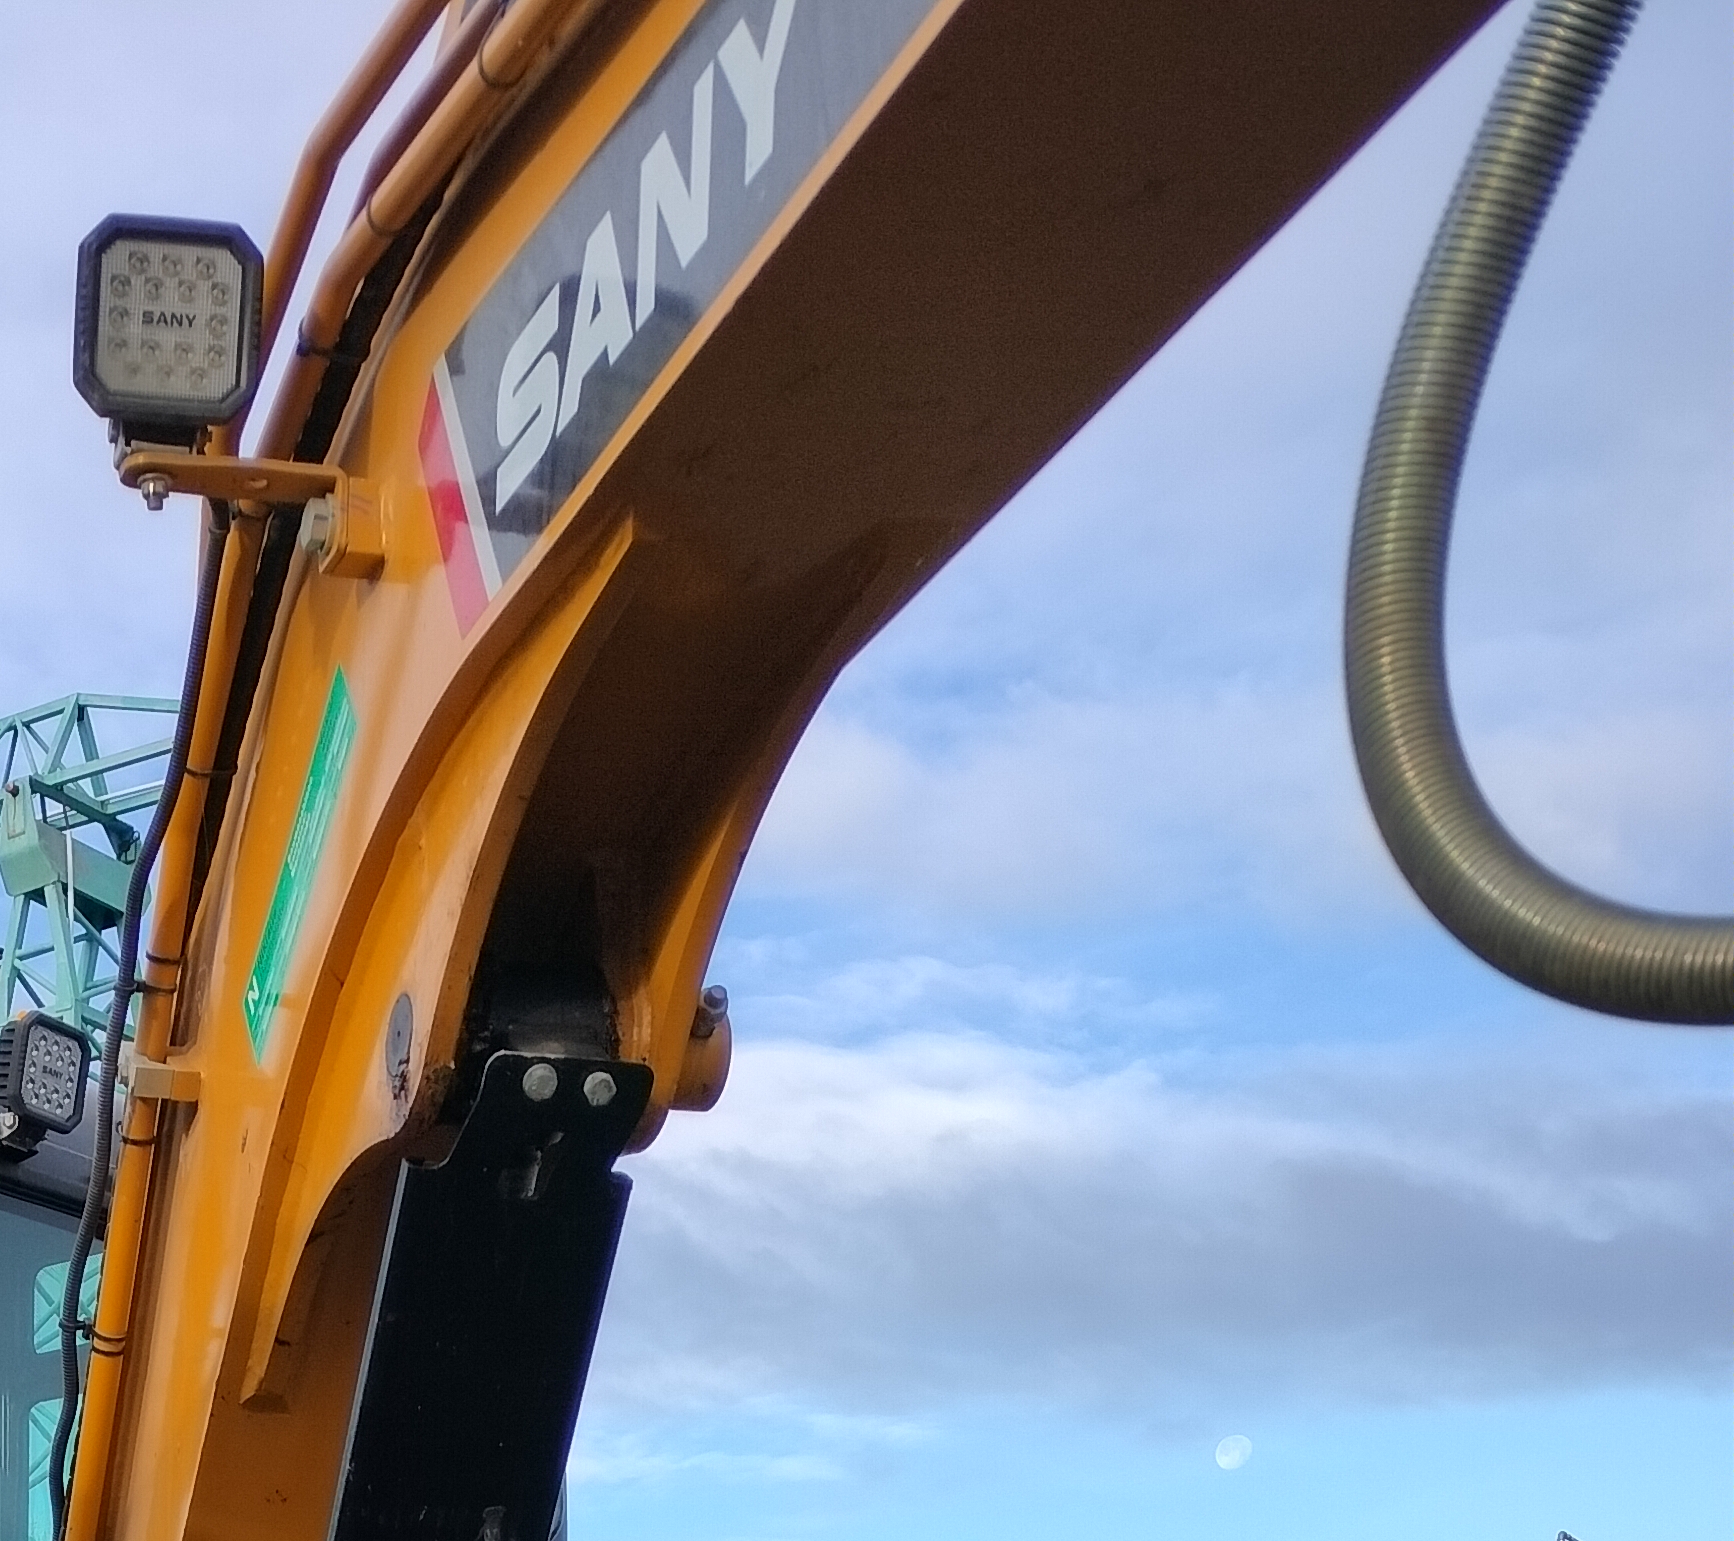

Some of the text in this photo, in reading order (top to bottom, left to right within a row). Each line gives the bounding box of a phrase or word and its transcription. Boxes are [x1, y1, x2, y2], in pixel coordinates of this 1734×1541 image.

[496, 0, 797, 516] SANY
[141, 311, 197, 328] SANY
[42, 1065, 64, 1080] SANY
